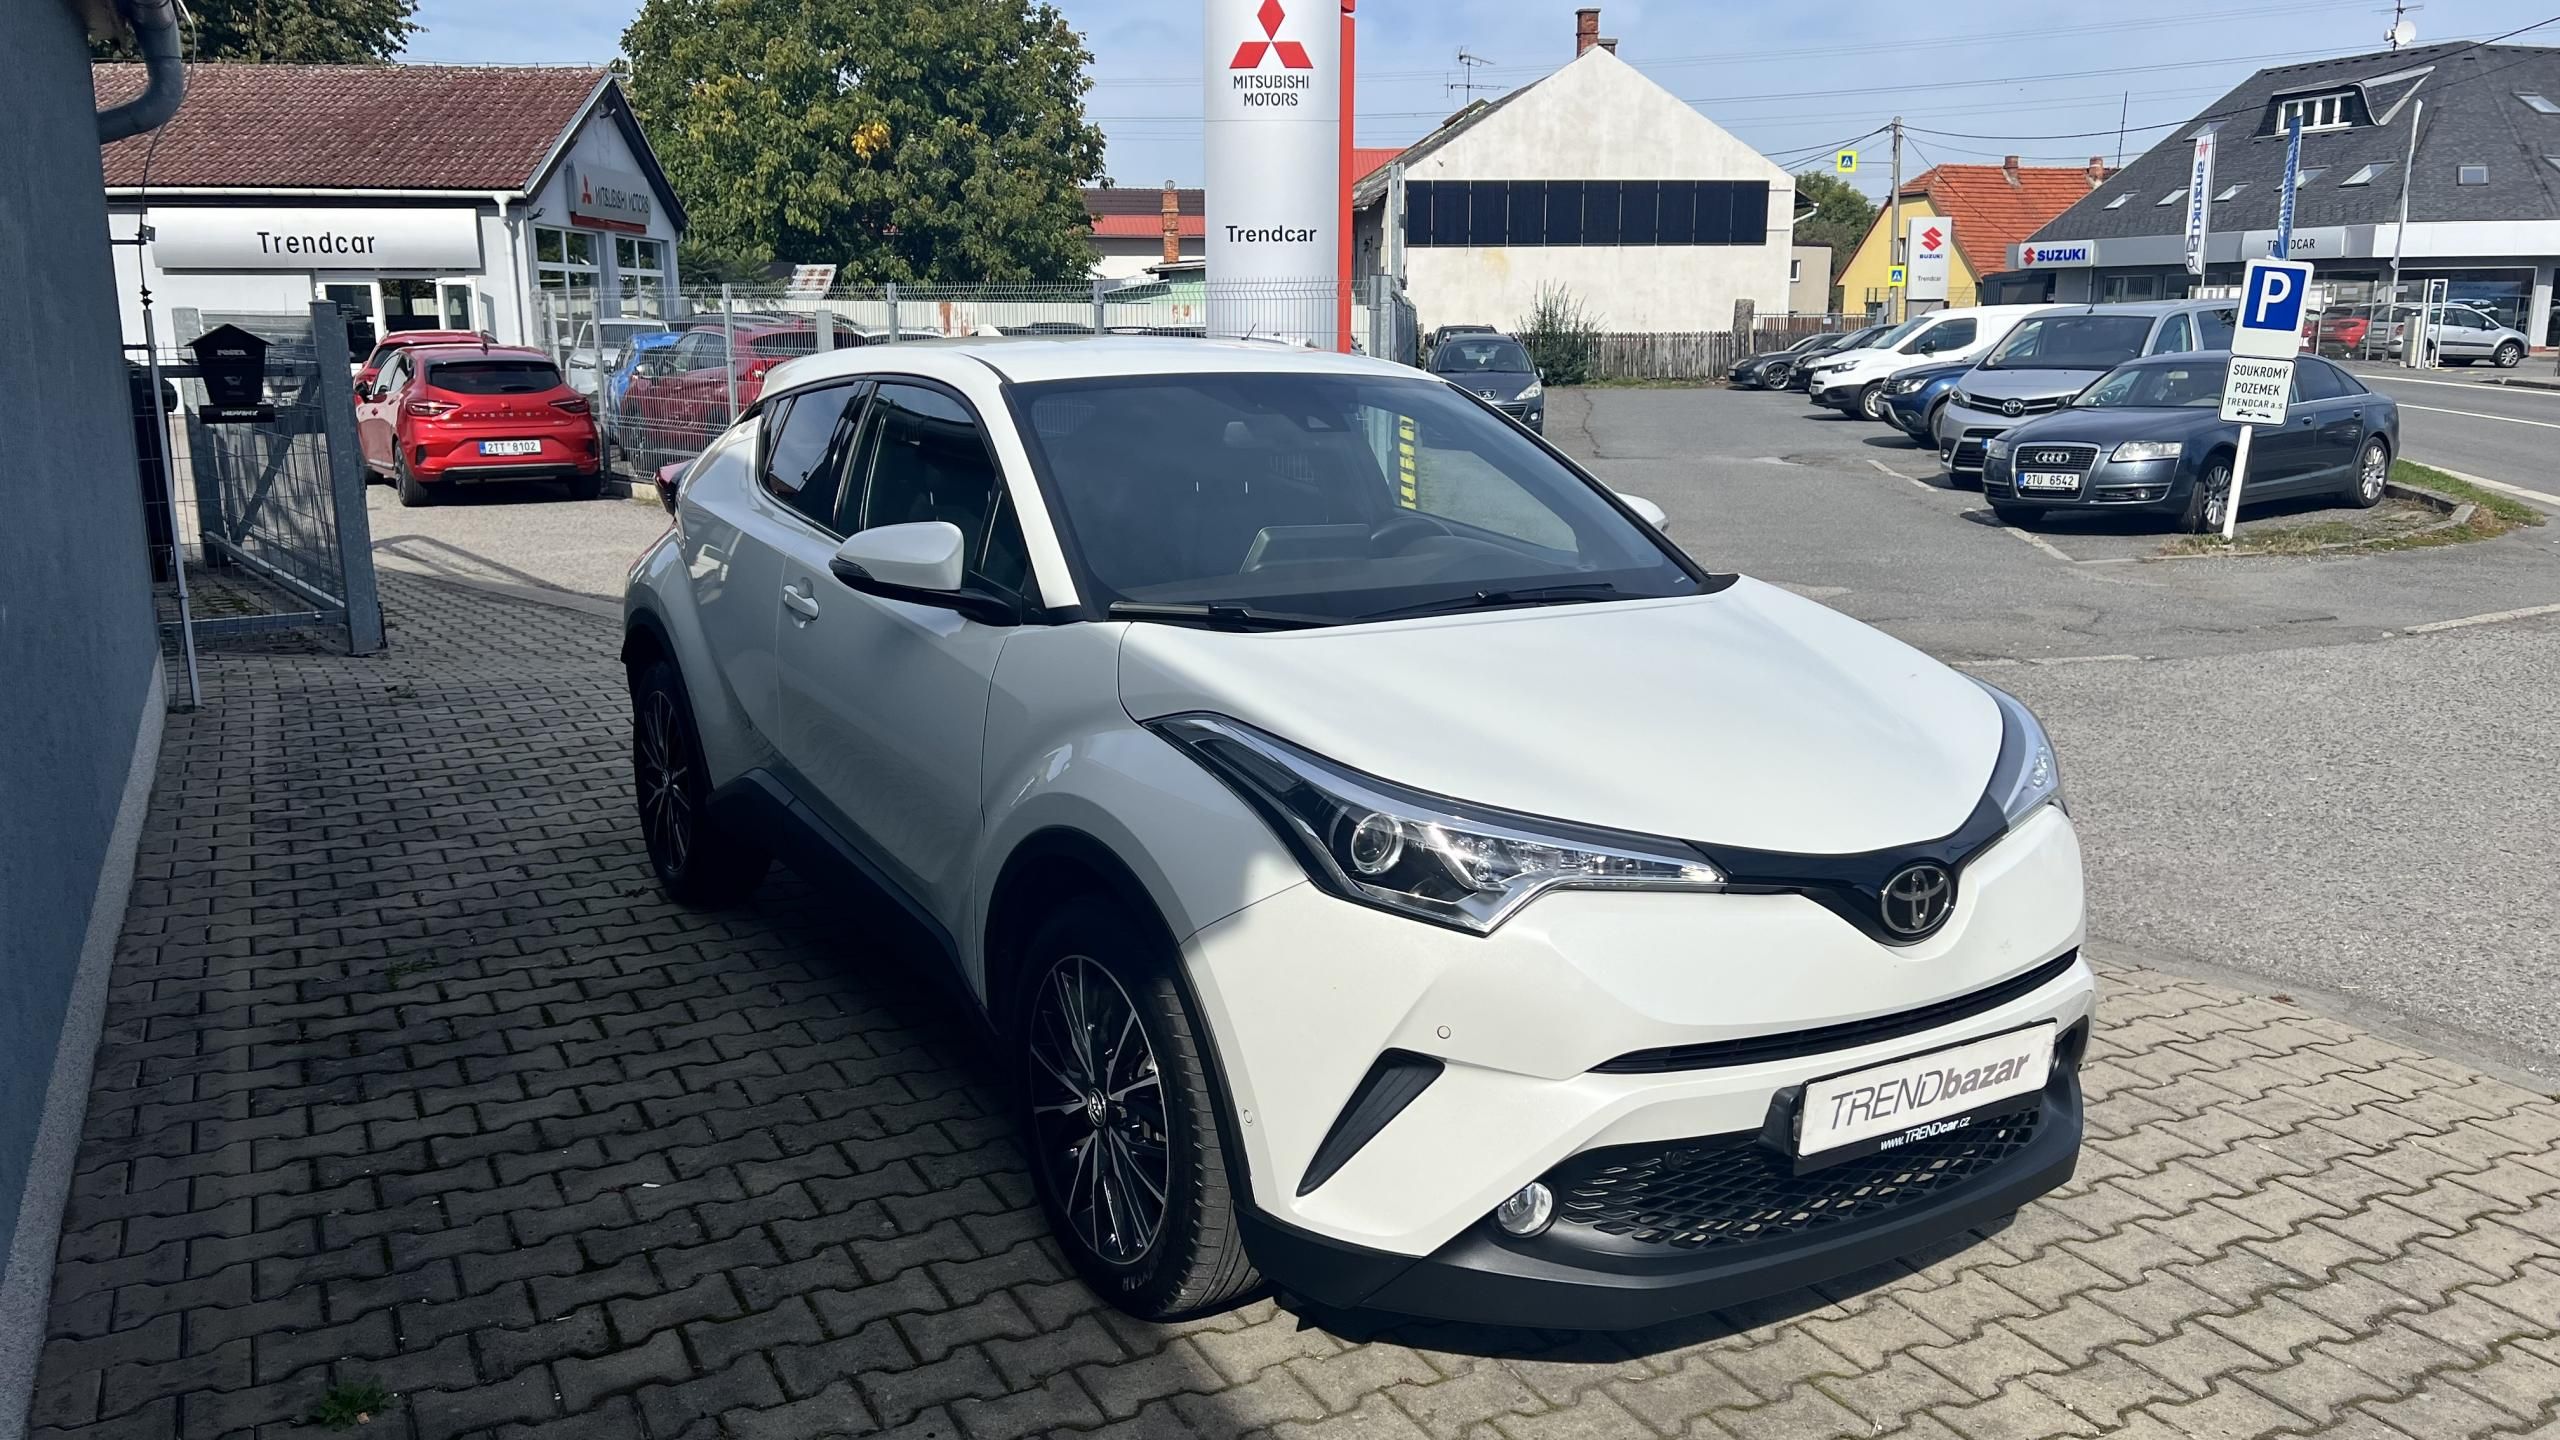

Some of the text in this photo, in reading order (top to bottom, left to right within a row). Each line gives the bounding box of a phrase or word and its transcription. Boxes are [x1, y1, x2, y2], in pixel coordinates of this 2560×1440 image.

[1233, 75, 1309, 89] MITSUBISHI
[1243, 92, 1298, 106] MOTORS
[1225, 225, 1317, 242] Trendcar
[257, 232, 375, 253] Trendcar
[2037, 248, 2086, 261] SUZUKI
[2256, 271, 2292, 323] P
[2233, 364, 2289, 379] SOUKROMÝ
[2234, 382, 2281, 396] POZEMEK
[2227, 397, 2269, 408] TRENDCAR
[488, 441, 536, 453] 2TT 8102
[2026, 474, 2074, 486] 2TU 6542
[1831, 1053, 2030, 1130] TRENDbazar
[1881, 1116, 1971, 1151] www.TRENDcar.cz
